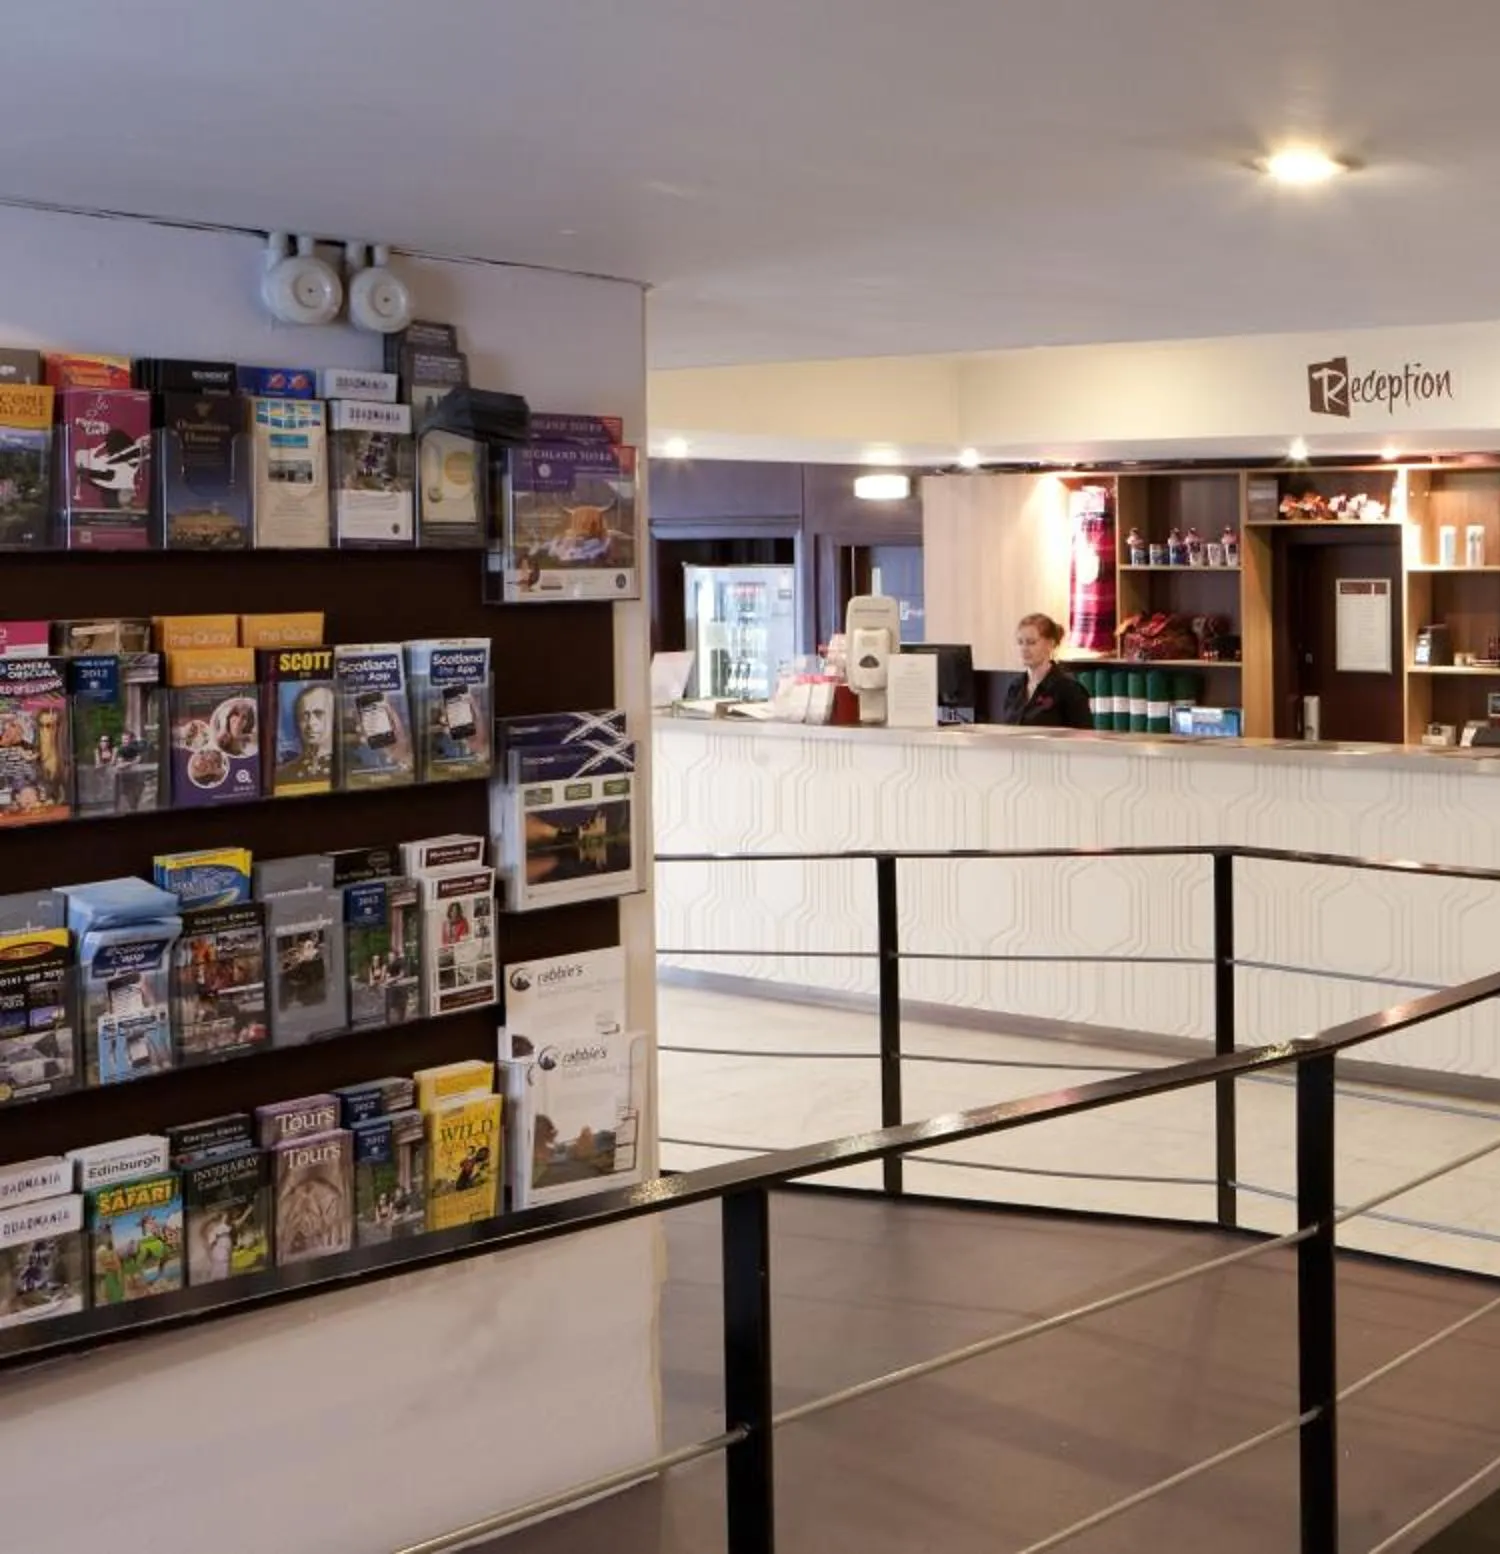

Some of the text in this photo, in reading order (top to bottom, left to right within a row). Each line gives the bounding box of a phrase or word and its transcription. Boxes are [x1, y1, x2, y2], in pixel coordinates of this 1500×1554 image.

[1308, 358, 1453, 416] Reception
[7, 661, 51, 671] CAMERA
[279, 651, 333, 672] SCOTT
[337, 658, 398, 674] Scotland
[433, 653, 484, 667] Scotland
[7, 669, 58, 679] OBSCURA
[80, 668, 108, 679] 2012
[537, 963, 584, 985] rabbie's
[561, 1047, 608, 1065] rabbie's
[275, 1107, 335, 1133] Tours
[440, 1119, 494, 1143] WILD
[88, 1153, 161, 1179] Edinburgh
[283, 1143, 341, 1168] Tours
[0, 1170, 61, 1196] UADMANIA
[99, 1184, 172, 1217] SAFARI
